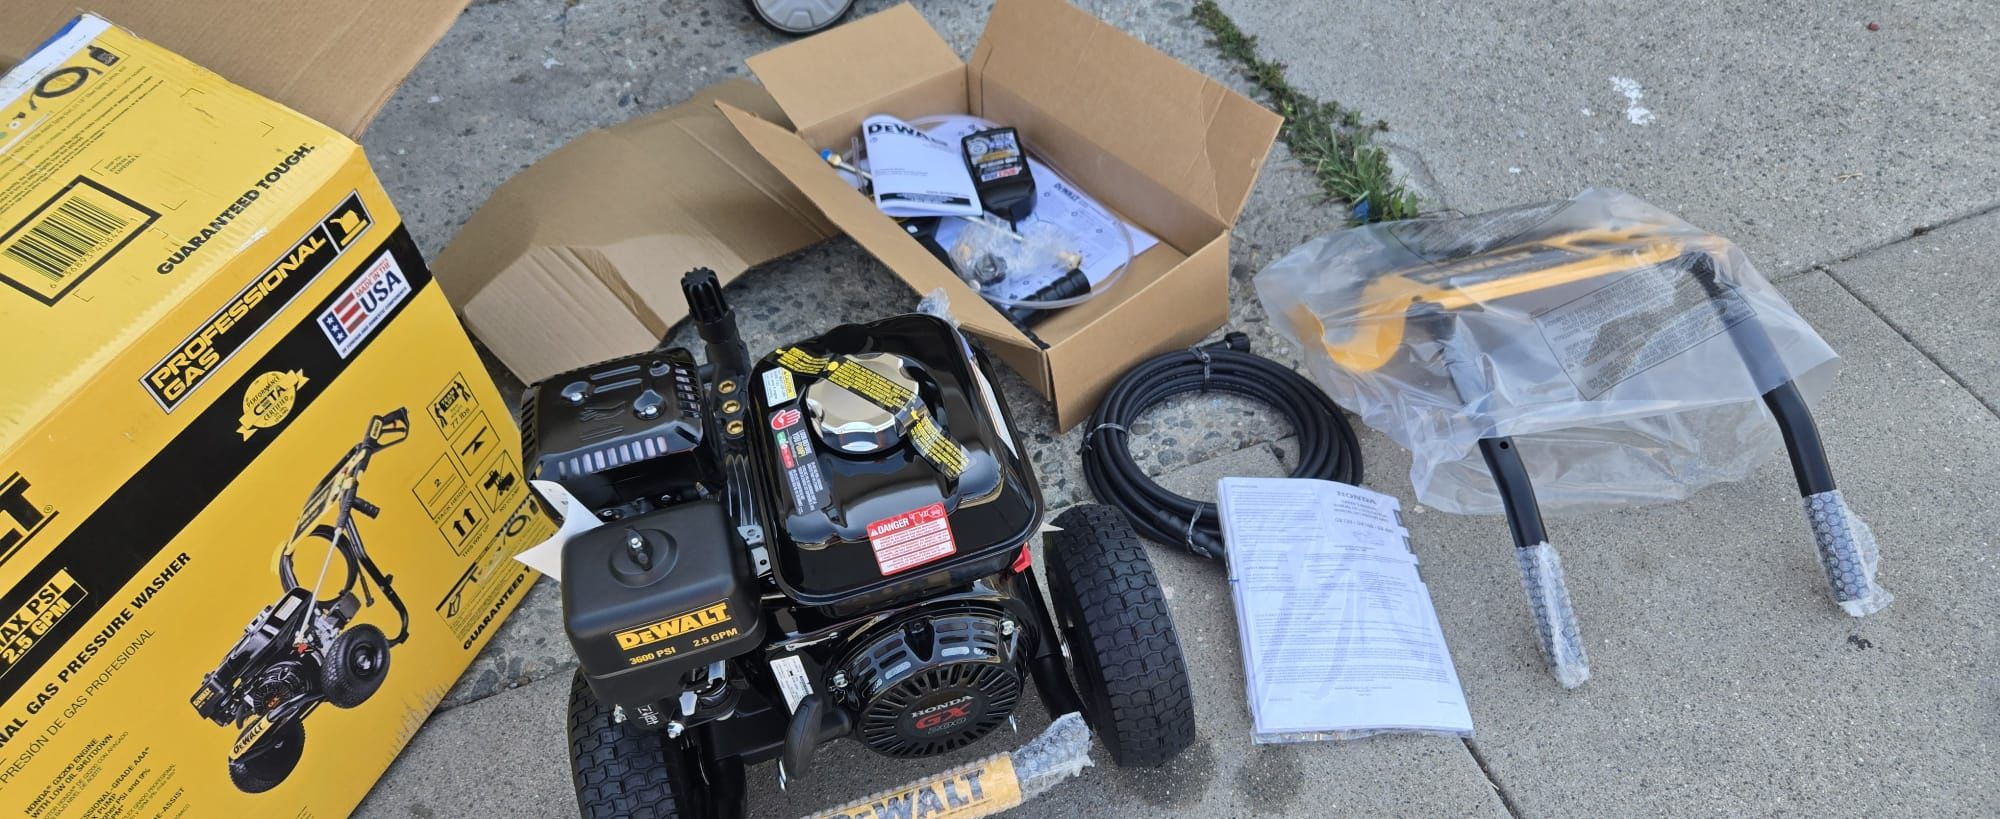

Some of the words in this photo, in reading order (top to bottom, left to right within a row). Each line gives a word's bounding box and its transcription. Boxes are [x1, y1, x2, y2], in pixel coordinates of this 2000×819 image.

[157, 189, 260, 275] GUARANTEED
[355, 280, 373, 297] MADE
[371, 272, 381, 281] IN
[379, 262, 391, 275] THE
[360, 270, 402, 313] USA
[150, 235, 327, 389] PROFESSIONAL
[163, 347, 220, 401] GAS
[246, 375, 281, 408] PERFORMANCE
[264, 395, 289, 421] CERTIFIED
[434, 478, 442, 488] 2
[877, 517, 910, 535] DANGER
[26, 582, 62, 616] PSI
[463, 573, 525, 650] GUARANTEED
[0, 717, 28, 748] NAL
[26, 682, 60, 715] GAS
[58, 607, 134, 684] PRESSURE
[131, 552, 191, 610] WASHER
[2, 635, 34, 666] 2.5
[31, 597, 73, 638] GPM
[629, 652, 655, 665] 3600
[655, 646, 677, 658] PSI
[692, 636, 710, 648] 2.5
[711, 627, 738, 642] GPM
[1, 734, 49, 785] PRESIÓN
[46, 717, 67, 737] DE
[63, 695, 88, 720] GAS
[85, 628, 156, 697] PROFESIONAL
[912, 696, 975, 718] HONDA
[915, 702, 973, 729] GX
[31, 799, 51, 818] WITH
[49, 783, 66, 800] LOW
[65, 773, 78, 784] OIL
[76, 734, 113, 772] SHUTDOWN
[52, 763, 75, 785] GX200
[73, 738, 100, 764] ENGINE
[44, 804, 58, 819] OTOR
[80, 765, 134, 819] SSIONAL-GRADE
[97, 792, 117, 815] PUMP
[102, 803, 118, 819] gher
[115, 791, 128, 805] PSI
[127, 779, 140, 793] and
[138, 767, 151, 780] 9%
[152, 786, 185, 819] E-ASSIST
[829, 767, 985, 819] WALT
